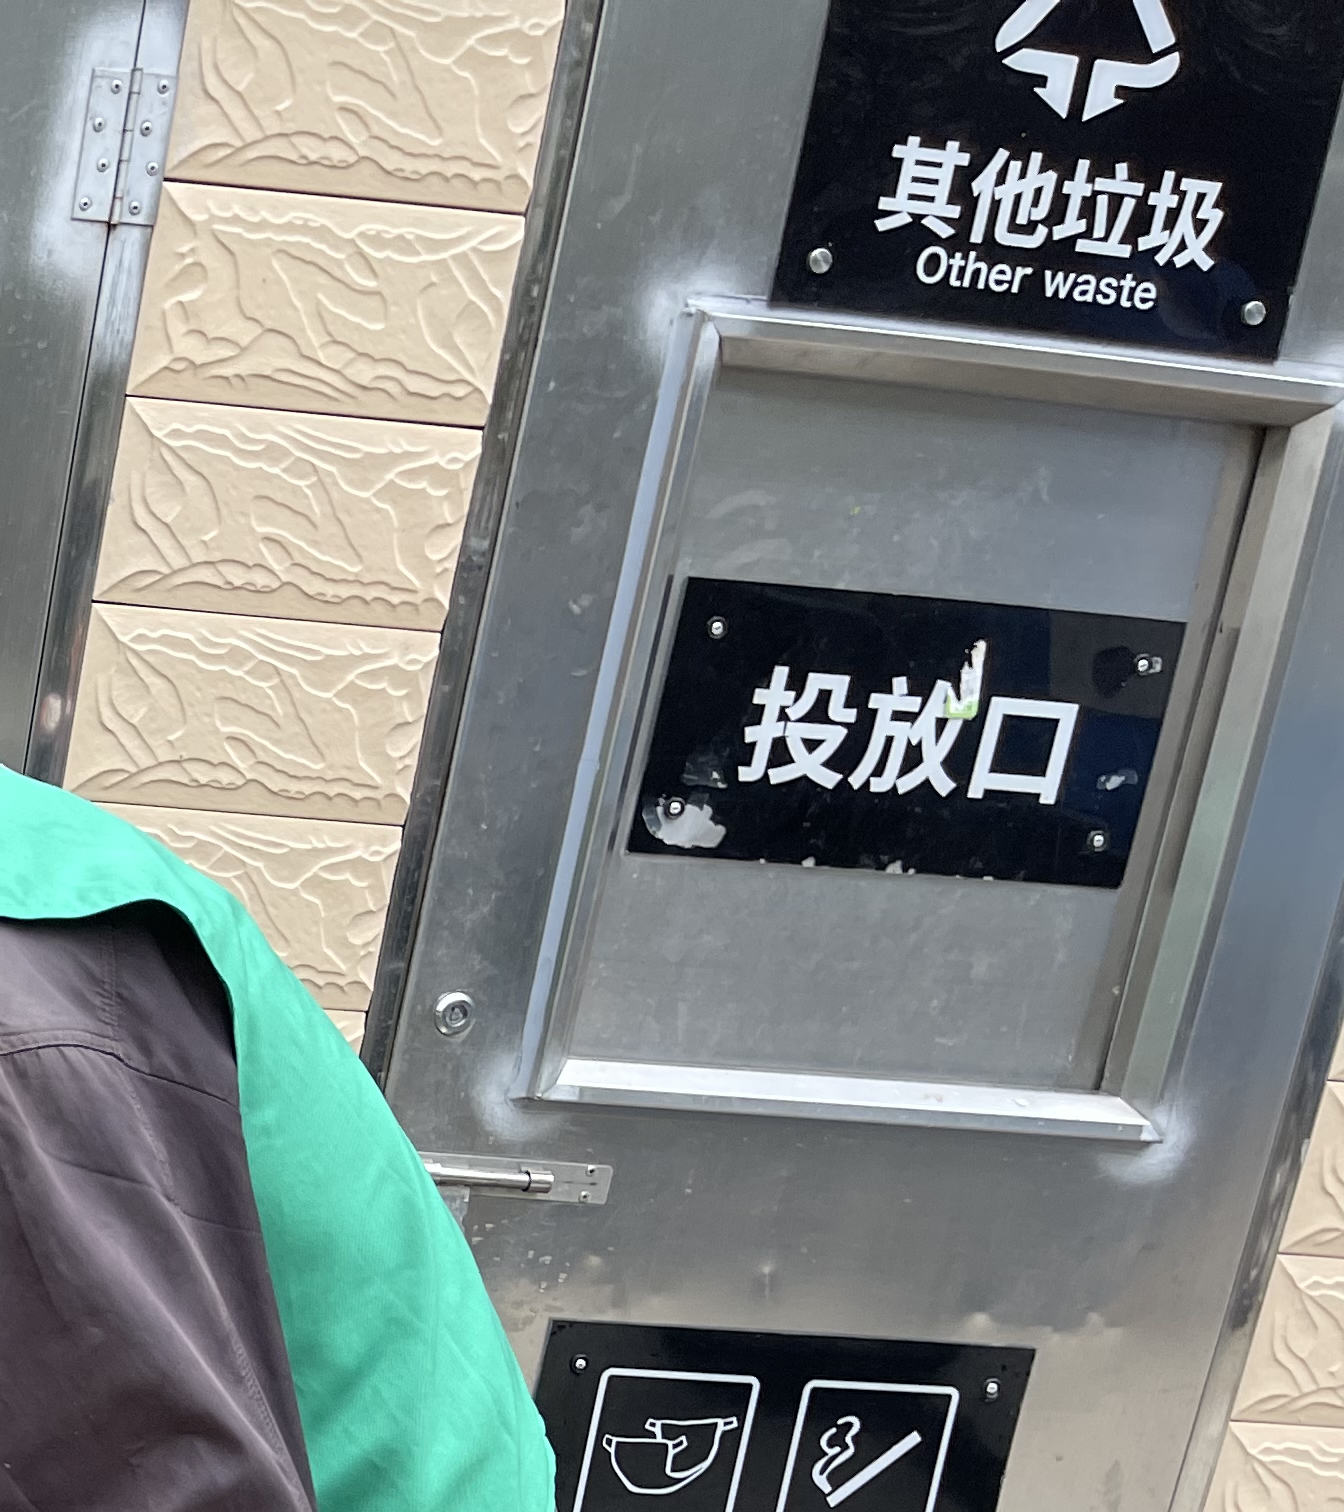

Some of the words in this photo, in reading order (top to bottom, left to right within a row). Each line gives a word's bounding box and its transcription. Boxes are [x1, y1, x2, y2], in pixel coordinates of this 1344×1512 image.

[874, 136, 1224, 272] 其他垃圾
[916, 245, 1032, 294] Other
[1044, 268, 1158, 310] waste
[738, 665, 1079, 805] 投放口
